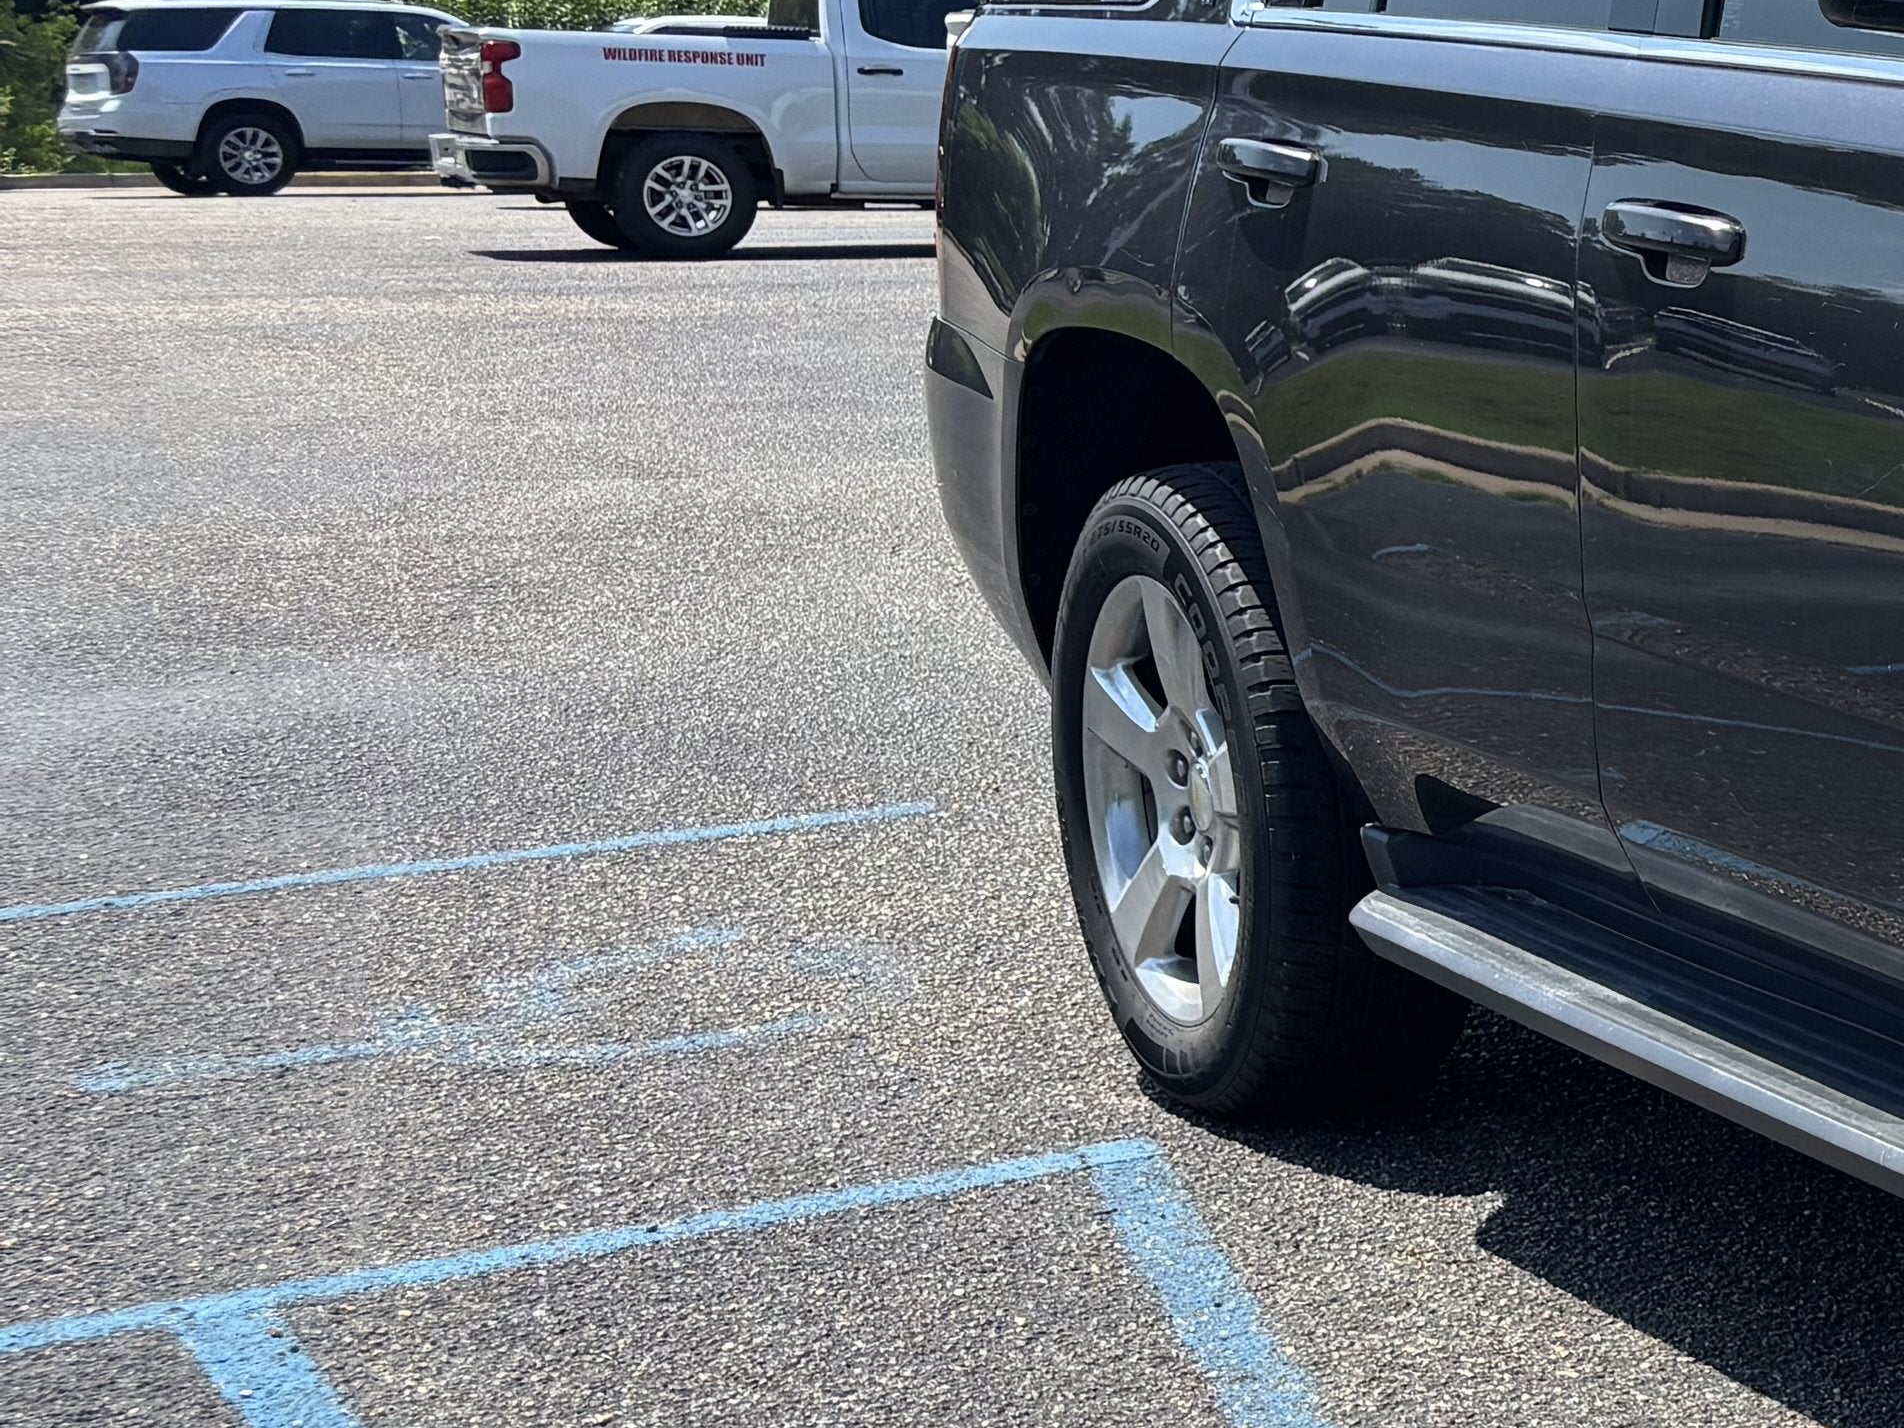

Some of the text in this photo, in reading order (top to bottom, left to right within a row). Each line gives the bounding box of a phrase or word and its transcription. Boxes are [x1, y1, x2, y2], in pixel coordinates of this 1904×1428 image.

[602, 47, 767, 67] WILDFIRE RESPONSE UNIT
